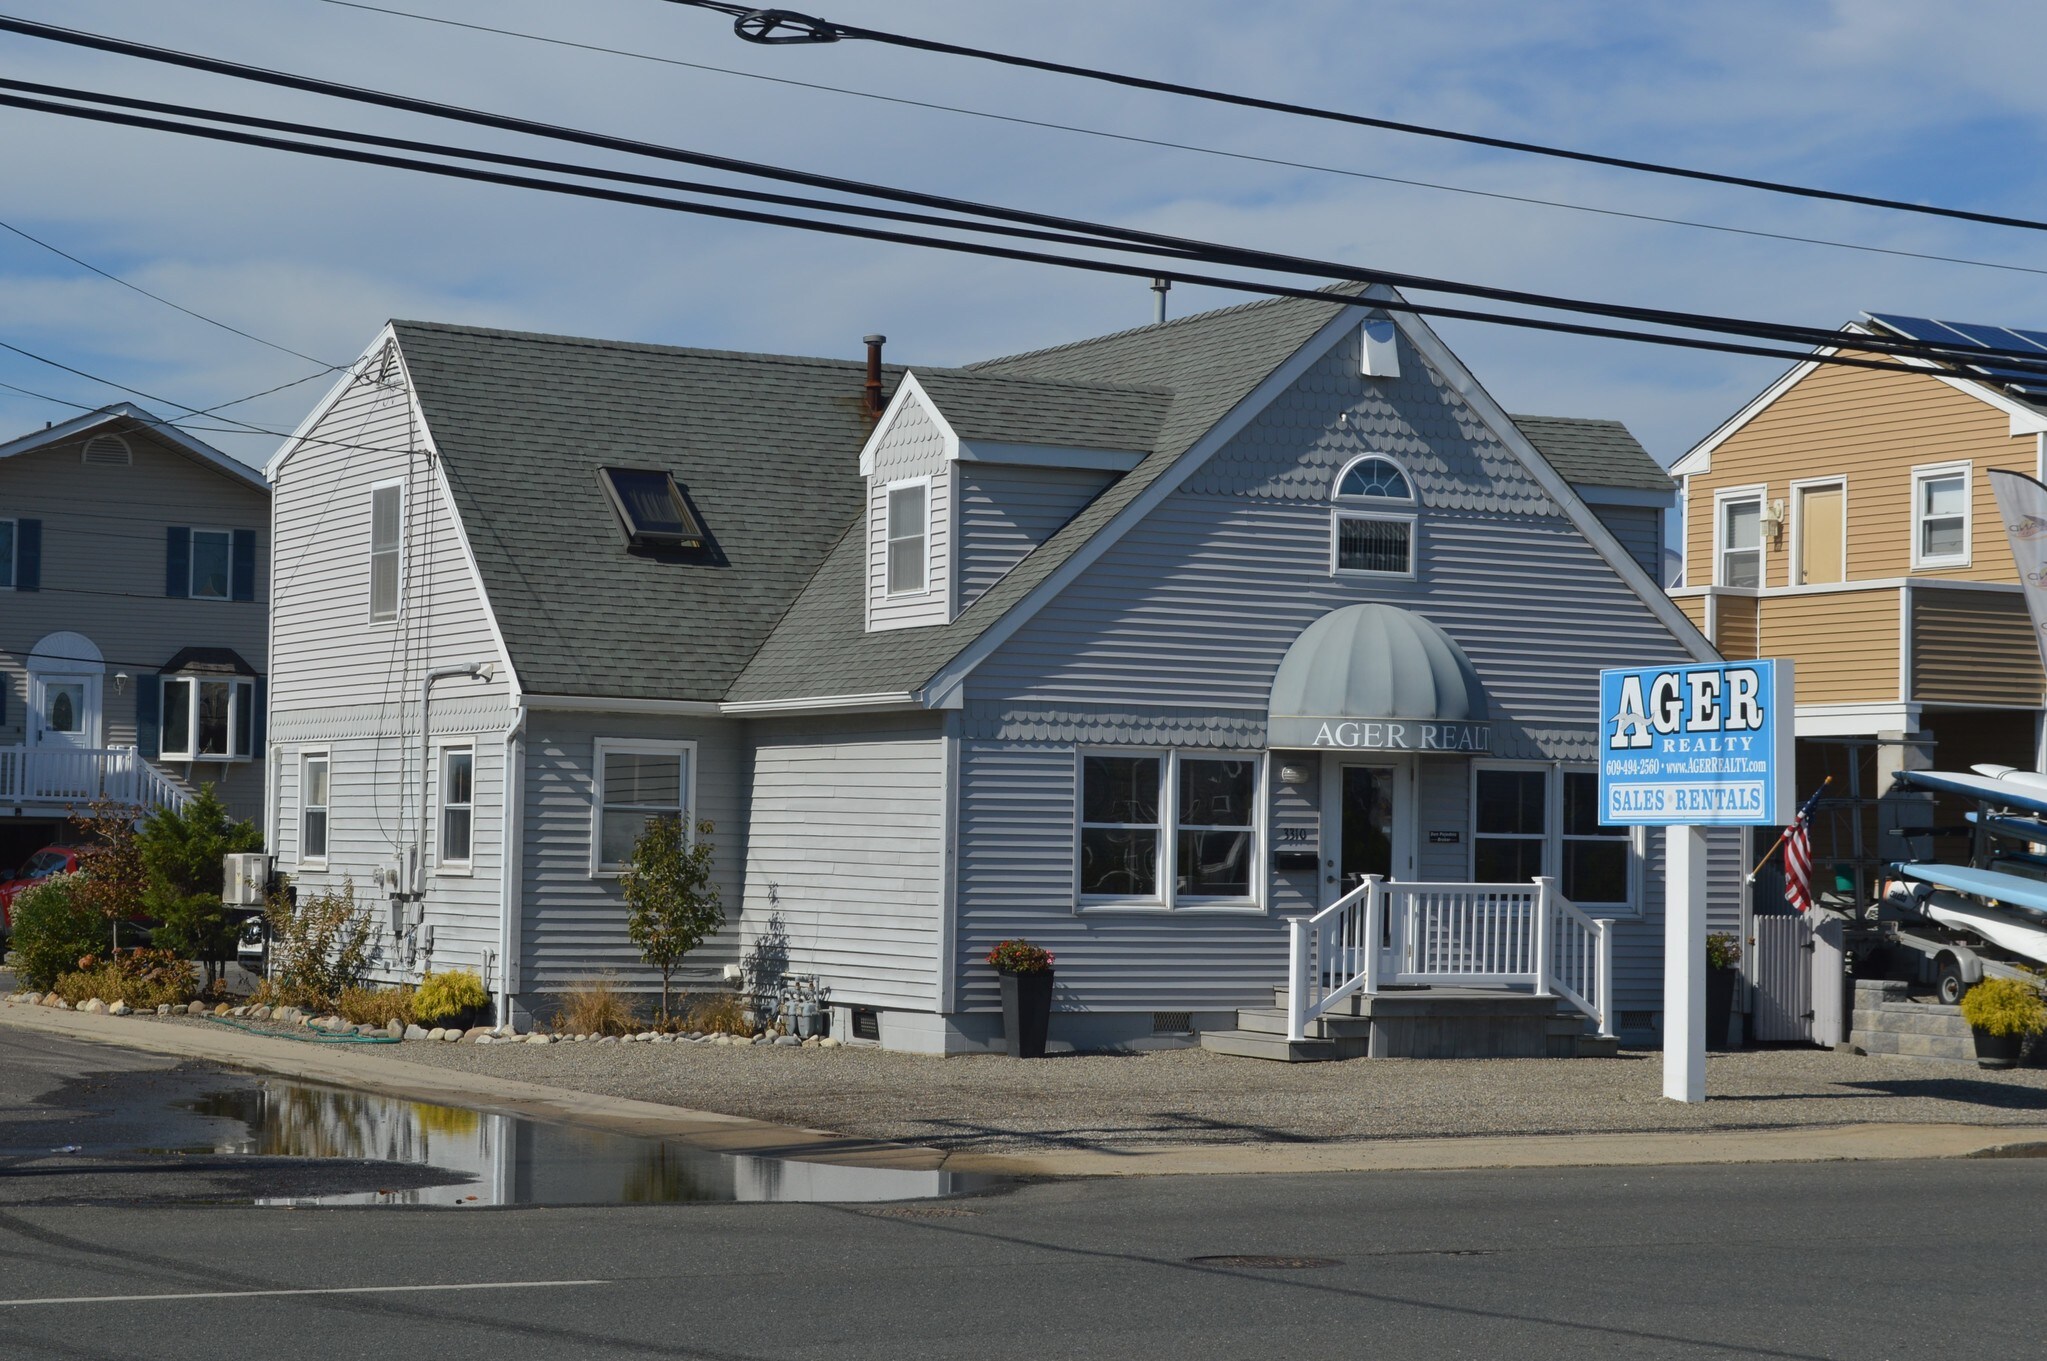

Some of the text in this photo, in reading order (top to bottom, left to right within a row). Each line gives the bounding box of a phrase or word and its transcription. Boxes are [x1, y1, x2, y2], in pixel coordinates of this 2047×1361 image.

[1610, 668, 1764, 750] AGER
[1312, 721, 1409, 748] AGER
[1663, 736, 1754, 753] REALTY
[1606, 758, 1660, 776] 609-494-2560
[1612, 787, 1761, 812] SALES RENTALS
[1283, 828, 1307, 841] 3310
